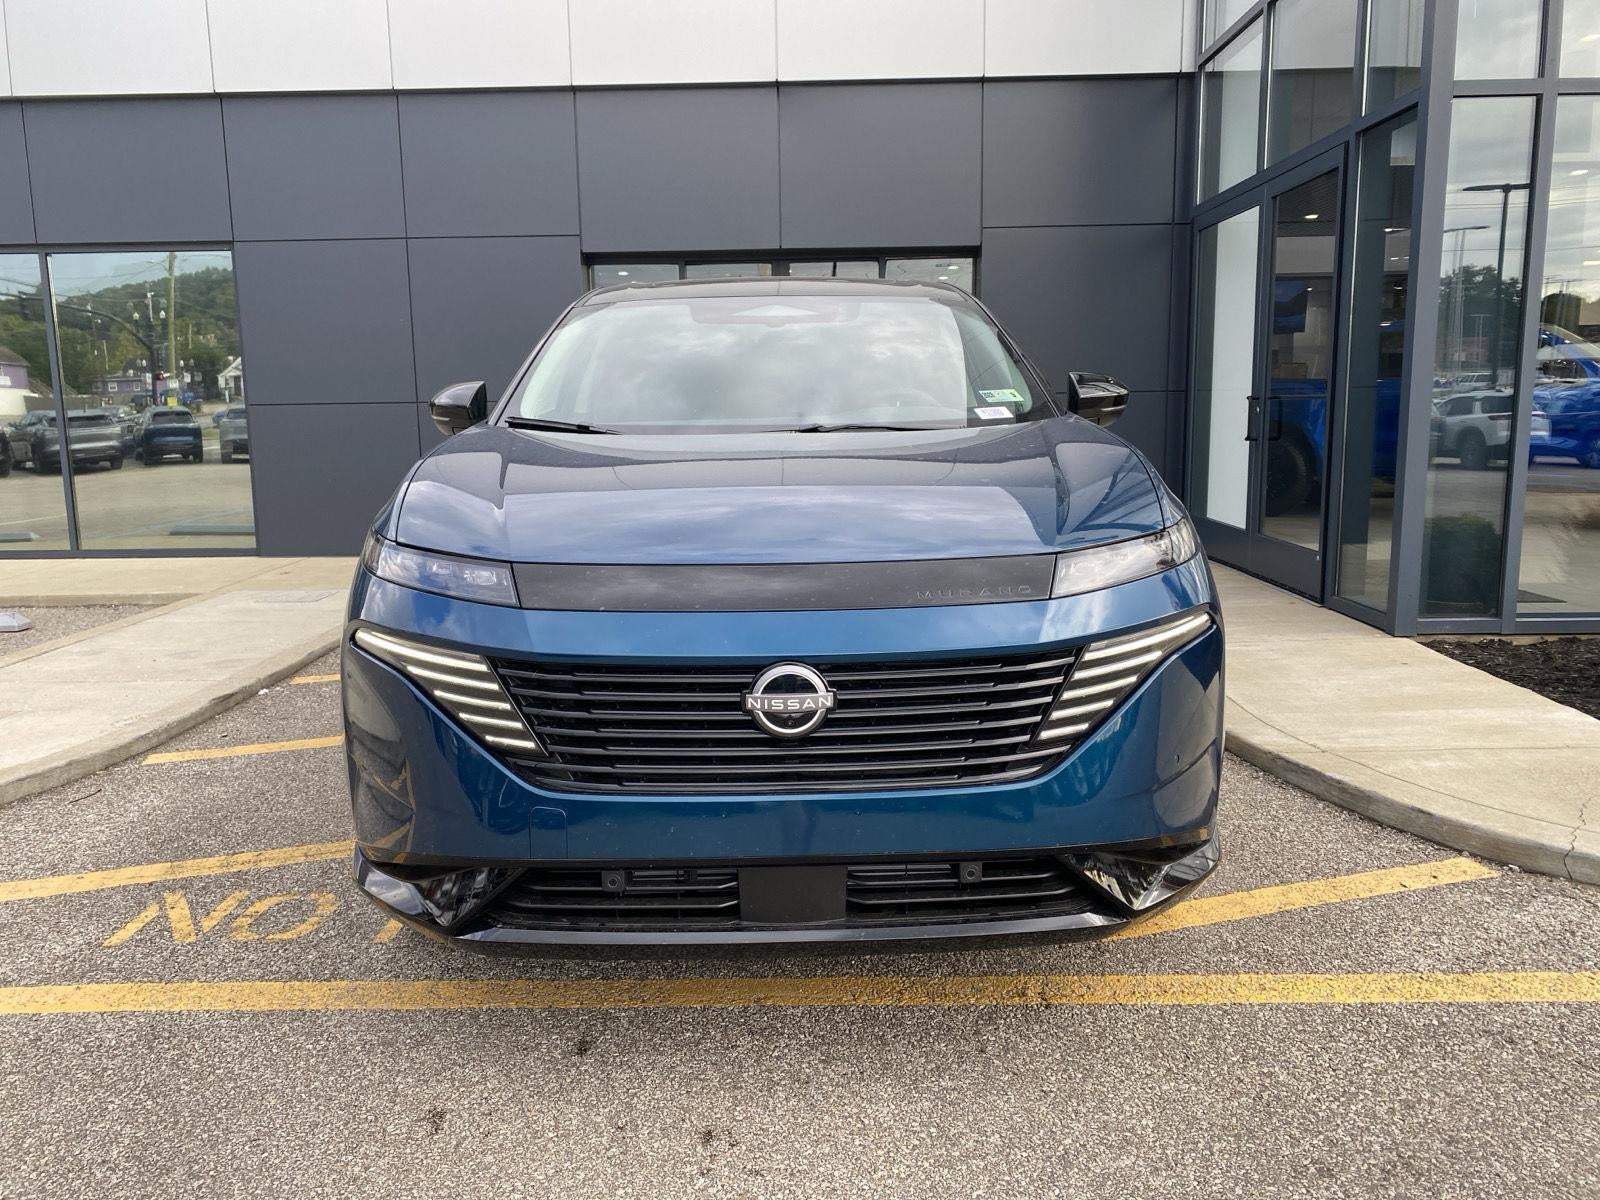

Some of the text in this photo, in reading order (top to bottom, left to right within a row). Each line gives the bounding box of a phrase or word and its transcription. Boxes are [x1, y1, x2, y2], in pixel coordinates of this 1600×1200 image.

[916, 584, 1031, 599] MURANO
[747, 696, 832, 710] NISSAN
[102, 890, 338, 948] NO
